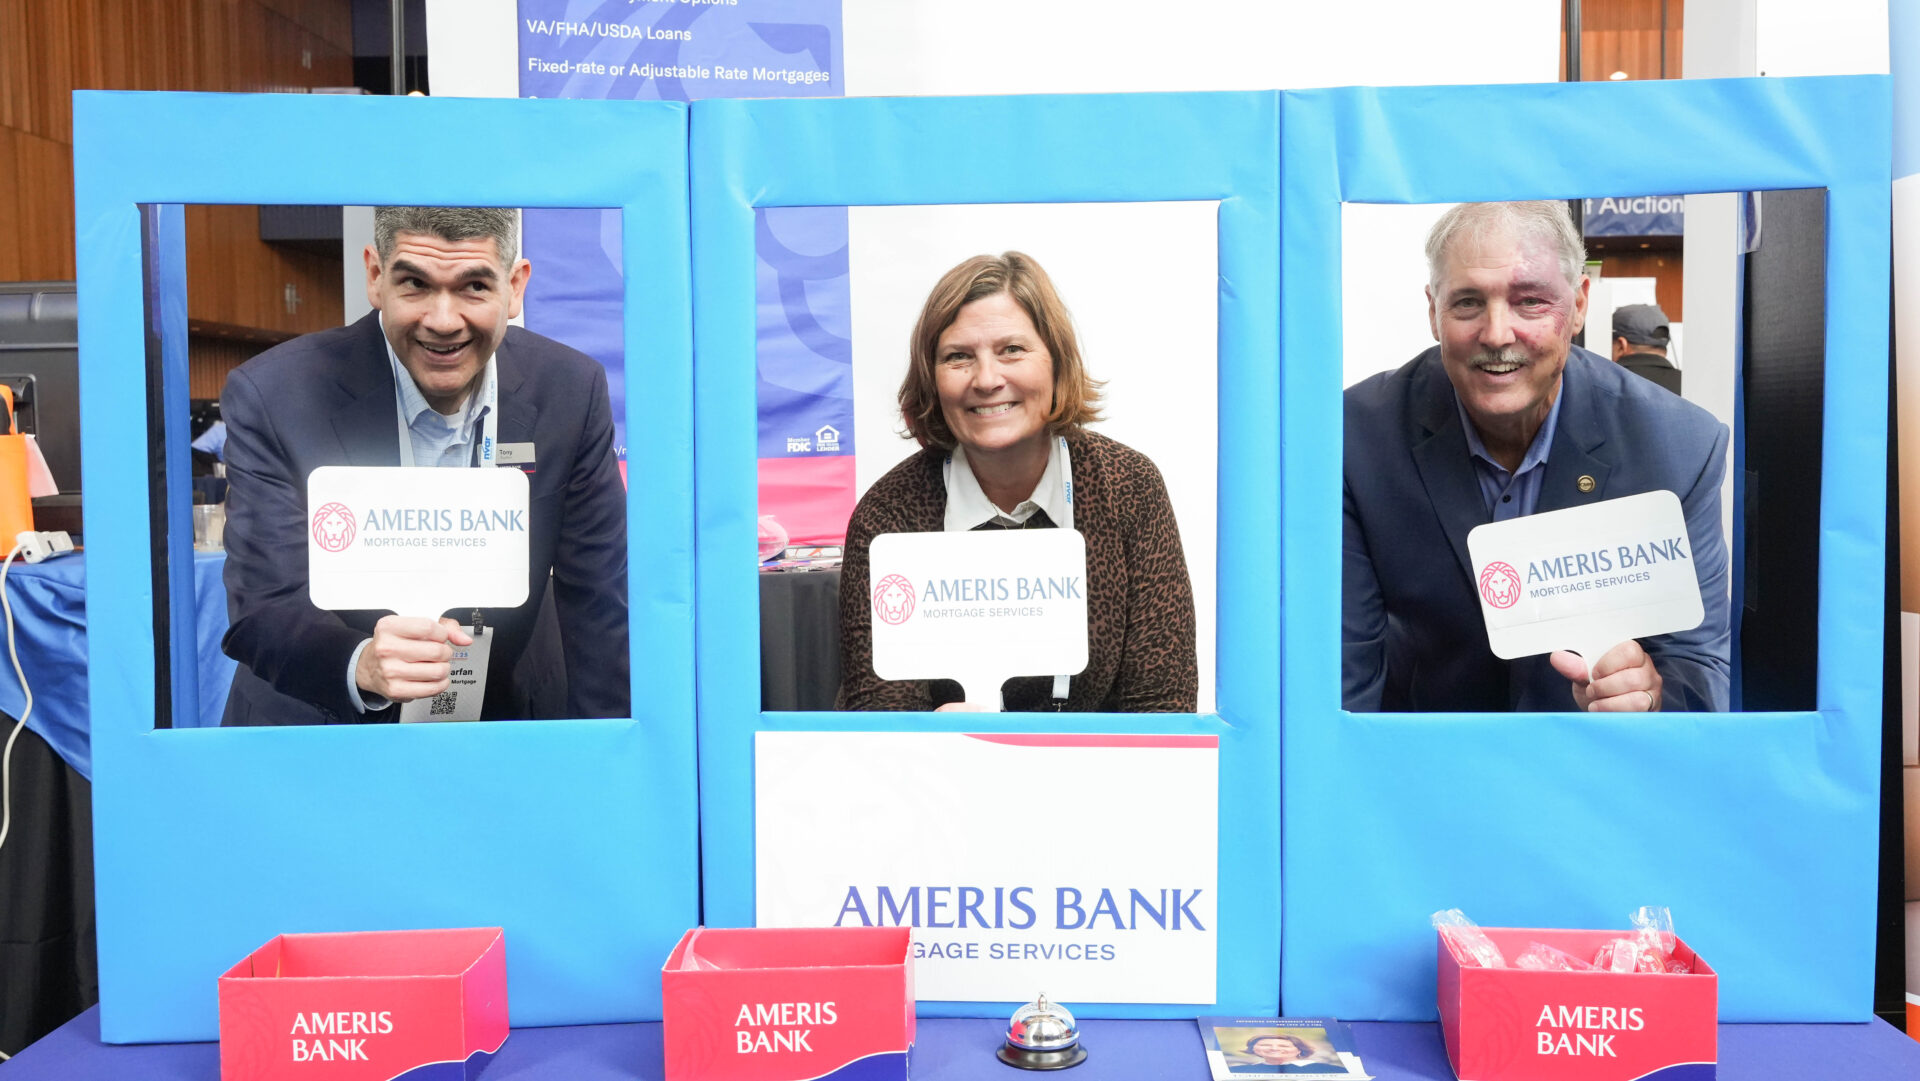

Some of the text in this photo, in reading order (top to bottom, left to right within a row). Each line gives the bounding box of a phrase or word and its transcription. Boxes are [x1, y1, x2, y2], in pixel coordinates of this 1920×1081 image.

[526, 19, 692, 41] VA/FHA/USDA Loans
[528, 57, 830, 84] Fixed-rate or Adjustable Rate Mortgages
[1598, 196, 1684, 214] Auction
[787, 442, 811, 453] FDIC
[363, 508, 525, 532] AMERIS BANK
[363, 537, 487, 548] MORTGAGE SERVICES
[1526, 537, 1688, 585] AMERIS BANK
[922, 576, 1081, 603] AMERIS BANK
[1529, 571, 1651, 599] MORTGAGE SERVICES
[922, 606, 1044, 619] MORTGAGE SERVICES
[450, 668, 473, 676] arfan
[833, 885, 1206, 932] AMERIS BANK
[914, 941, 1117, 961] GAGE SERVICES
[290, 1011, 394, 1035] AMERIS
[734, 1001, 838, 1027] AMERIS
[1535, 1004, 1646, 1031] AMERIS
[292, 1038, 369, 1062] BANK
[736, 1029, 813, 1054] BANK
[1537, 1031, 1618, 1058] BANK
